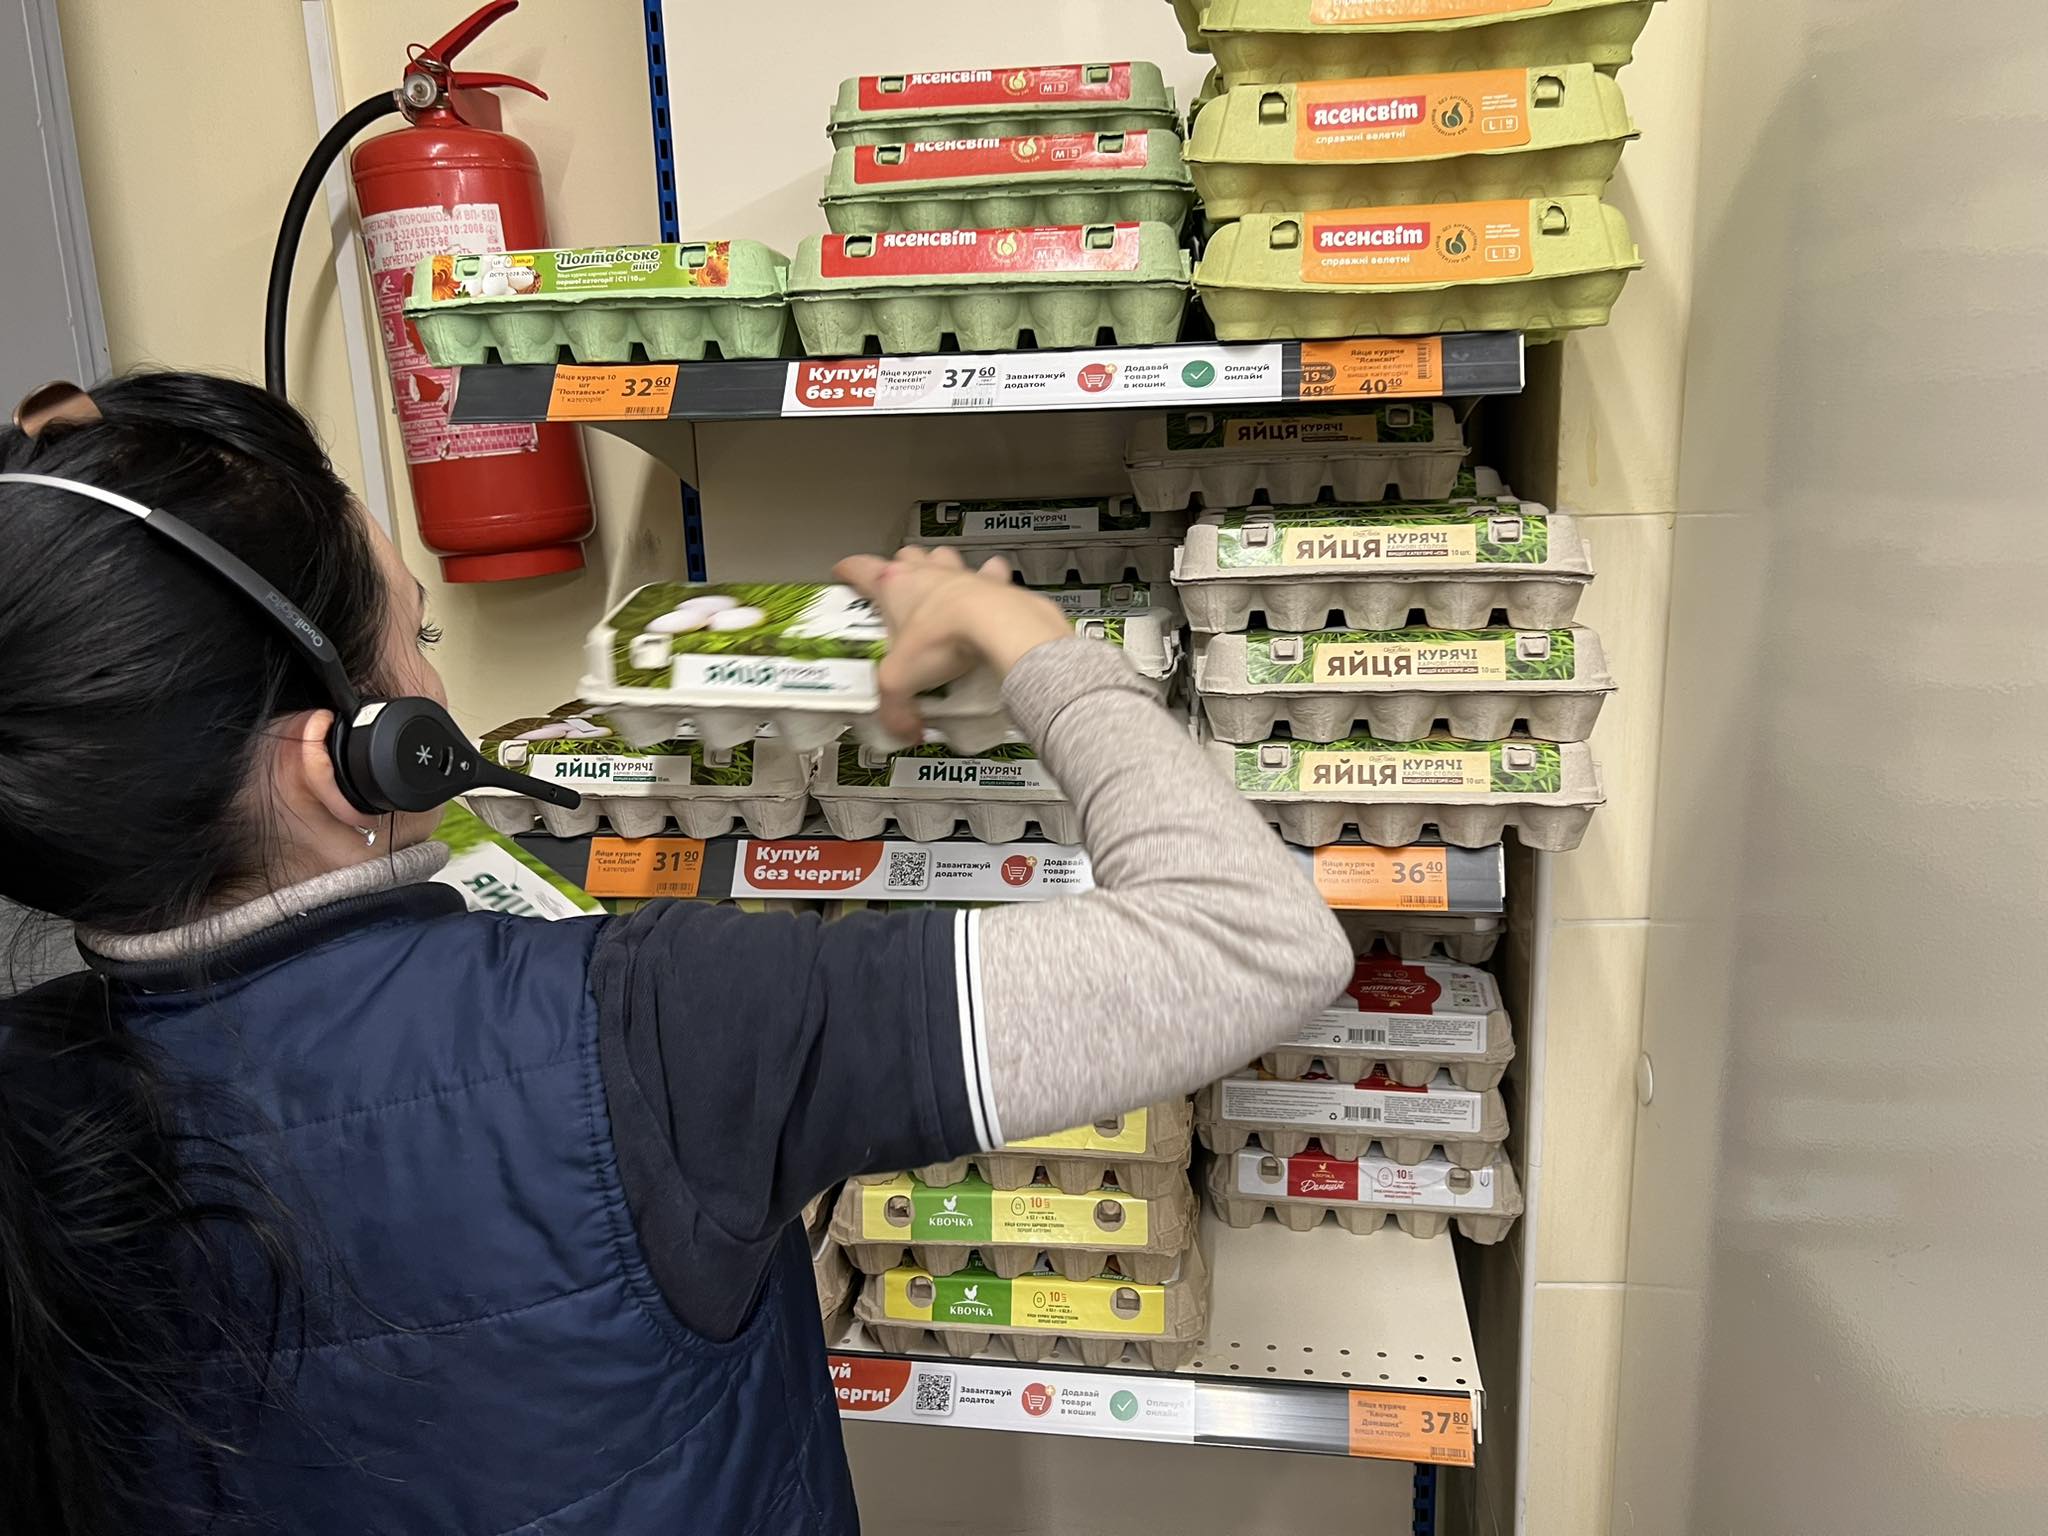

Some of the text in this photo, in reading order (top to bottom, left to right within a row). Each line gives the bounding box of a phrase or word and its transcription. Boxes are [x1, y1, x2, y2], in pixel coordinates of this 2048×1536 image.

[556, 249, 659, 269] Полтавське
[880, 369, 932, 378] Яйце куряче
[1124, 363, 1169, 373] Додавай
[1224, 364, 1270, 375] Оплачуй
[809, 365, 877, 384] Купуй
[942, 368, 976, 388] 37
[979, 366, 996, 376] 60
[1005, 371, 1066, 381] Завантажуй
[1124, 373, 1160, 382] товари
[1224, 373, 1263, 381] онлайн
[621, 376, 671, 397] 32 60
[1004, 381, 1046, 390] додаток
[1131, 381, 1166, 389] кошик
[1302, 385, 1322, 396] 49
[1359, 377, 1402, 394] 40 40
[806, 384, 844, 400] без
[1238, 422, 1298, 441] ЯЙЦЯ
[1301, 423, 1343, 432] КУРЯЧІ
[984, 513, 1031, 530] ЯЙЦЯ
[1033, 514, 1067, 522] КУРЯЧІ
[1296, 532, 1448, 560] ЯЙЦЯ КУРЯЧІ
[1327, 650, 1412, 677] ЯЙЦЯ
[1417, 649, 1478, 660] КУРЯЧІ
[555, 758, 611, 779] ЯЙЦЯ
[613, 762, 653, 771] КУРЯЧІ
[918, 761, 1022, 783] ЯЙЦЯ КУРЯЧІ
[1313, 758, 1462, 786] ЯЙЦЯ КУРЯЧІ
[756, 846, 820, 864] Купуй
[653, 850, 699, 872] 31 90
[935, 861, 991, 871] Завантажуй
[1043, 858, 1084, 867] Додавай
[753, 864, 862, 886] без черги!
[935, 870, 973, 880] додаток
[1043, 868, 1076, 876] товари
[1391, 861, 1443, 884] 36 40
[1396, 1169, 1407, 1179] 10
[1030, 1197, 1042, 1208] 10
[929, 1217, 973, 1227] КВОЧКА
[1049, 1291, 1060, 1302] 10
[949, 1306, 993, 1317] КВОЧКА
[960, 1385, 1012, 1397] Завантажуй
[1061, 1388, 1099, 1398] Додавай
[959, 1396, 995, 1405] додаток
[1061, 1398, 1092, 1407] товари
[1067, 1409, 1097, 1417] кошик
[1421, 1411, 1451, 1434] 37
[1453, 1411, 1469, 1423] 80
